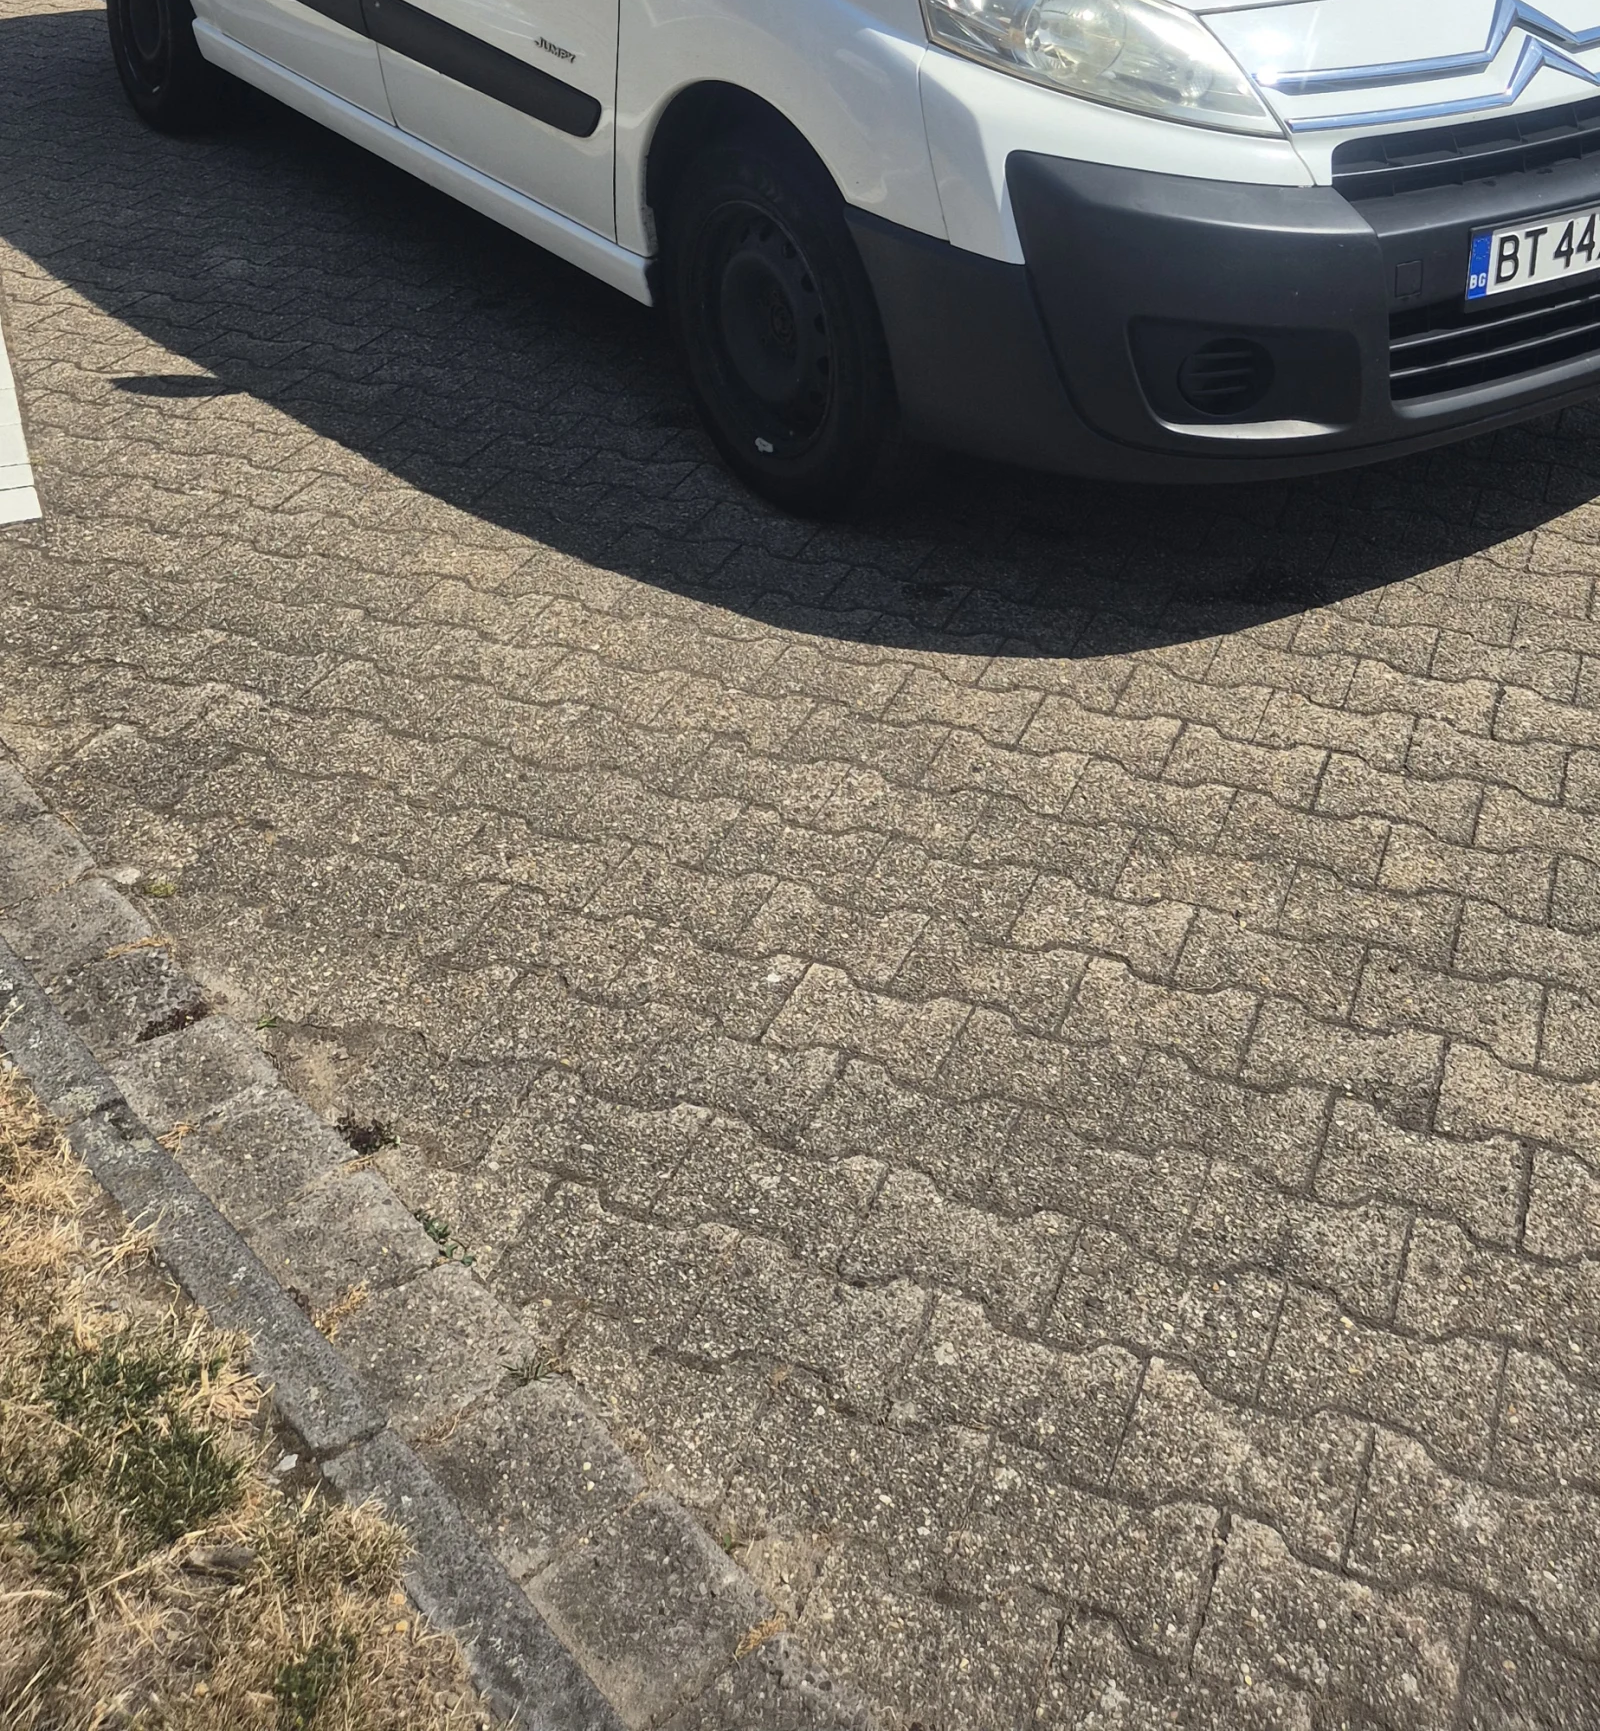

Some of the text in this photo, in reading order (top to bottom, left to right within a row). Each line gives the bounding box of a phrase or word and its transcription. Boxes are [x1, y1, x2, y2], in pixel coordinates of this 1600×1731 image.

[534, 36, 576, 64] JUMPY
[1494, 212, 1600, 286] BT 44
[1469, 272, 1487, 289] BG
